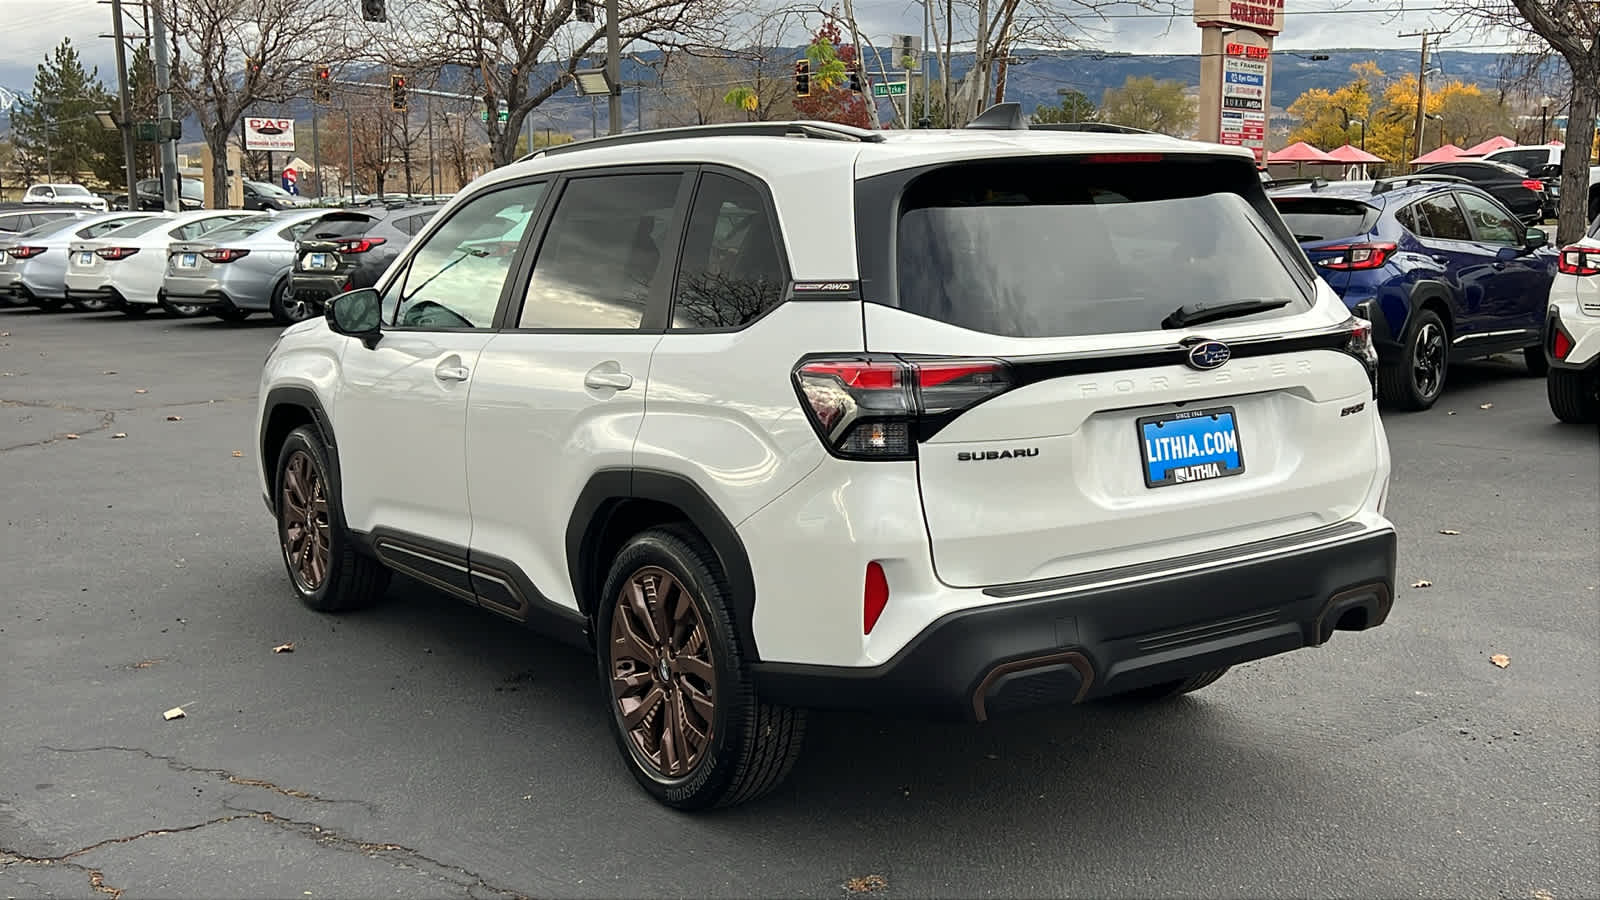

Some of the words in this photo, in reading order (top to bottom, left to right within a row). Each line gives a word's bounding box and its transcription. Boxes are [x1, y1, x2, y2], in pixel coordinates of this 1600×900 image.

[249, 119, 289, 129] CAC
[1078, 359, 1313, 399] FORESTER
[957, 447, 1039, 461] SUBARU
[1145, 429, 1238, 463] LITHIA.COM
[1185, 462, 1222, 481] LITHIA
